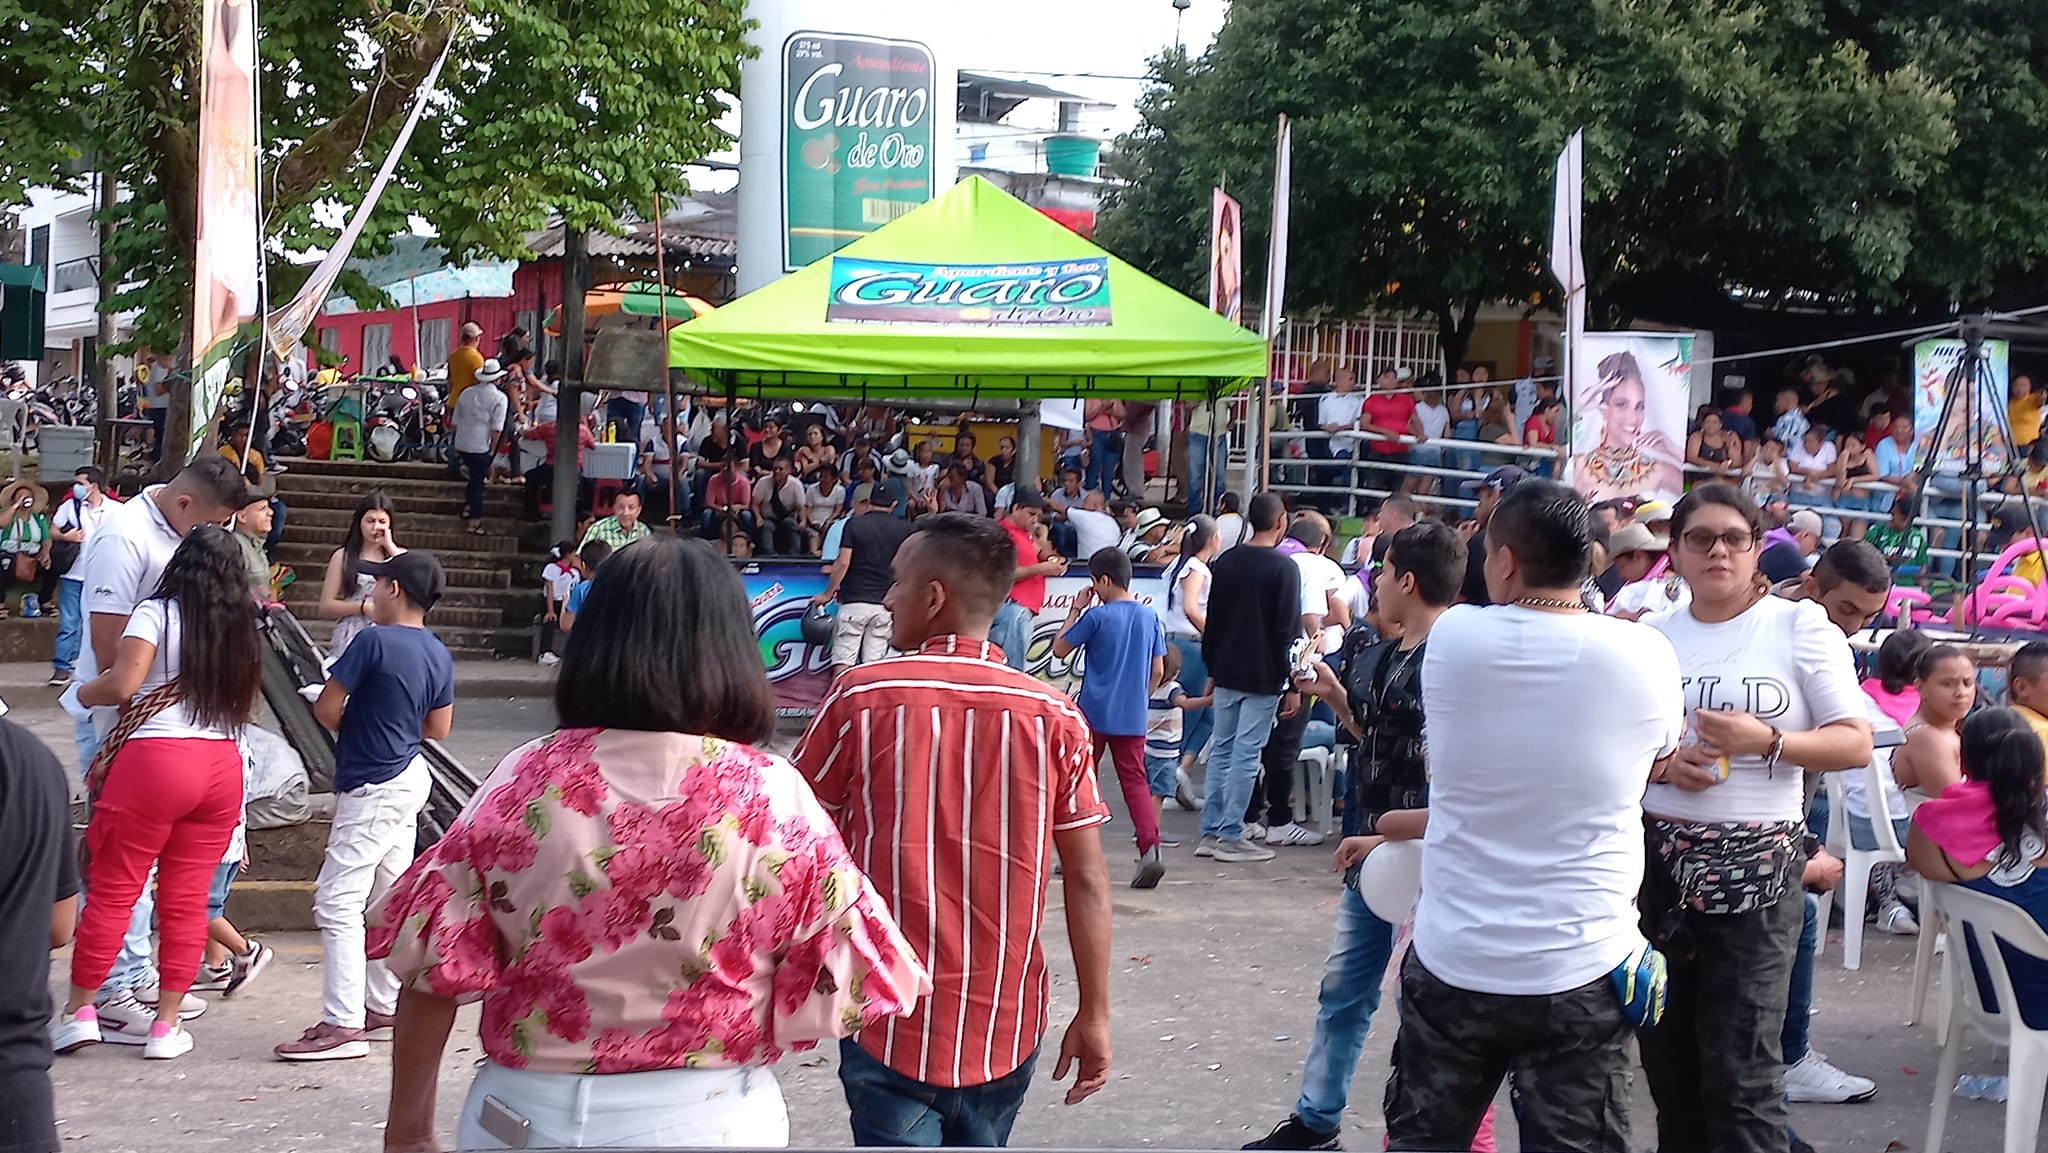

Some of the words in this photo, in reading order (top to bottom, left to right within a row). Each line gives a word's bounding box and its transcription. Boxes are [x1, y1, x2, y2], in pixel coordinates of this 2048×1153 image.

[793, 62, 927, 130] Guaro
[848, 131, 876, 168] de
[878, 132, 924, 169] Oro
[835, 270, 1107, 306] Guaro
